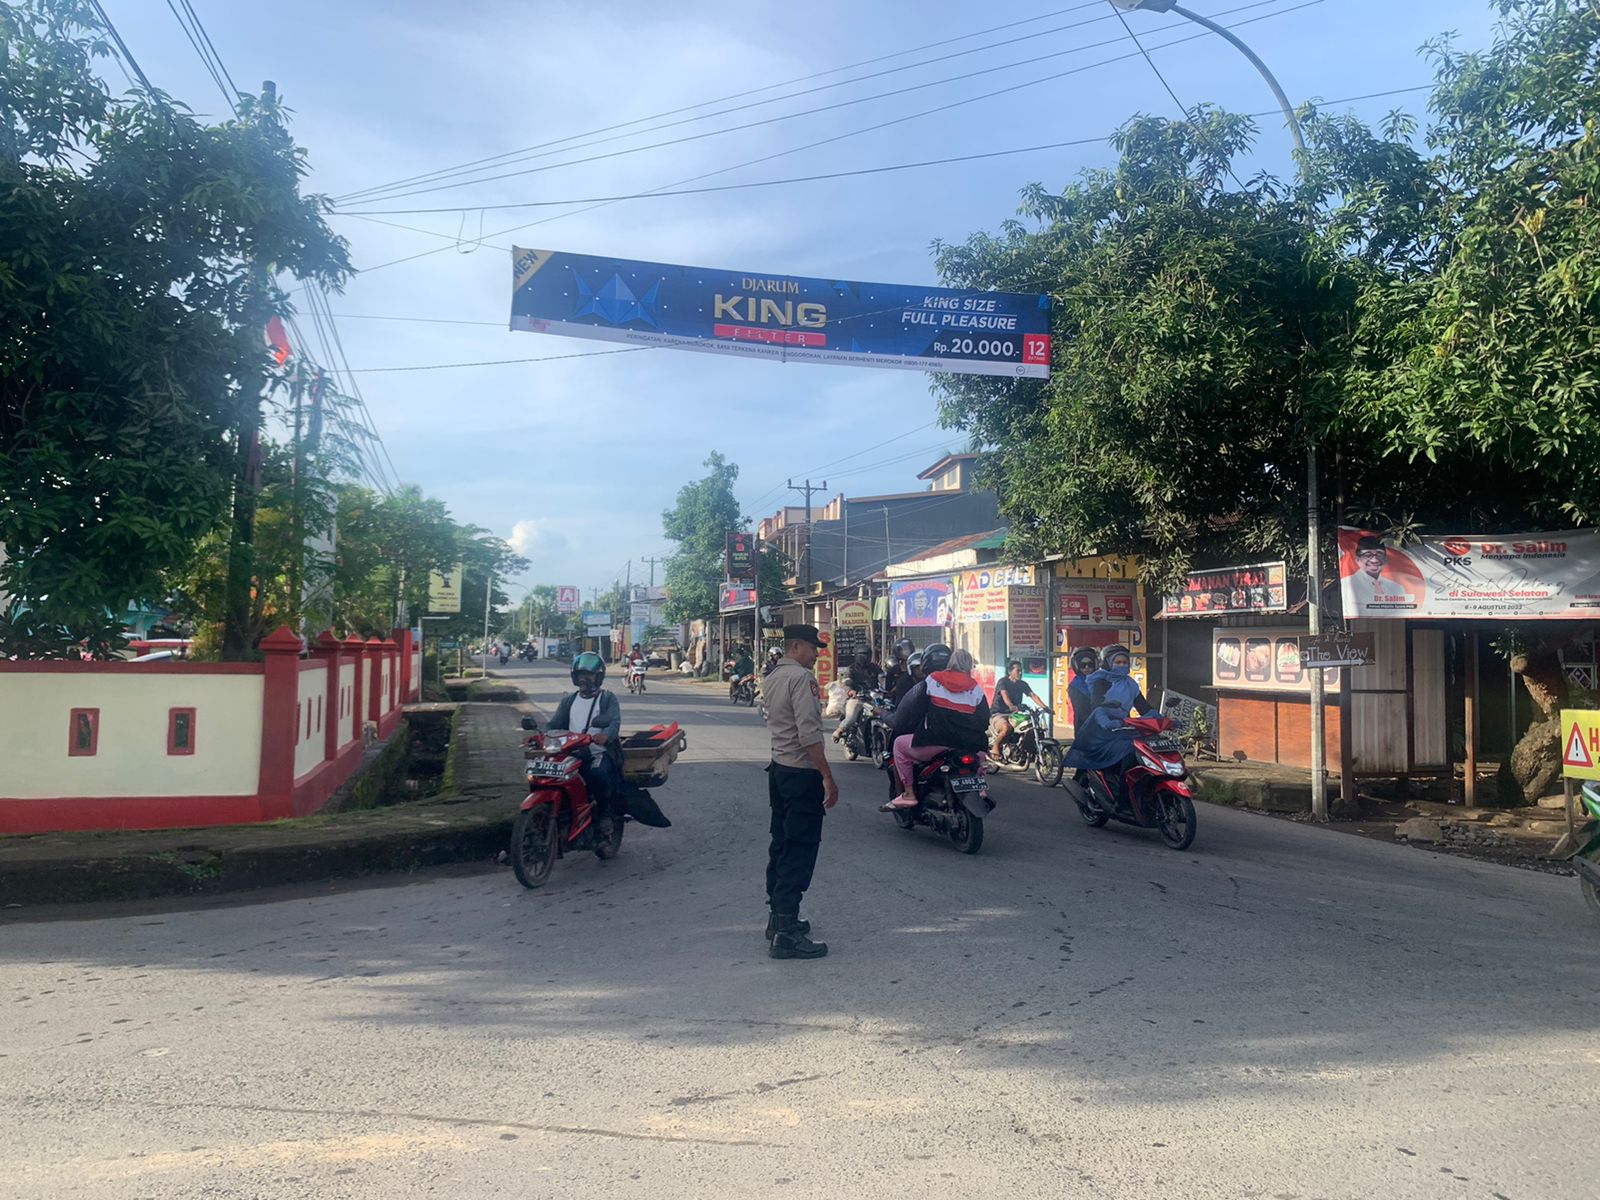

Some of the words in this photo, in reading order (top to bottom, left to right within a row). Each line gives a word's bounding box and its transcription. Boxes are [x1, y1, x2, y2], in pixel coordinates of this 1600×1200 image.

[513, 249, 539, 279] NEW
[742, 277, 800, 294] DJARUM
[714, 293, 827, 328] KING
[923, 296, 960, 310] KING
[963, 298, 996, 312] SIZE
[902, 311, 937, 325] FULL
[941, 313, 1017, 330] PLEASURE
[734, 328, 806, 343] FILTER
[1028, 341, 1045, 356] 12
[1481, 544, 1507, 554] Dr.
[1512, 541, 1568, 554] Salim
[1443, 557, 1472, 566] PKS
[1480, 553, 1521, 561] Menyapa
[1522, 552, 1566, 560] Indonesia
[966, 571, 991, 590] AD
[1460, 590, 1506, 598] Sulawesi
[1307, 646, 1331, 661] The
[1336, 644, 1369, 660] View
